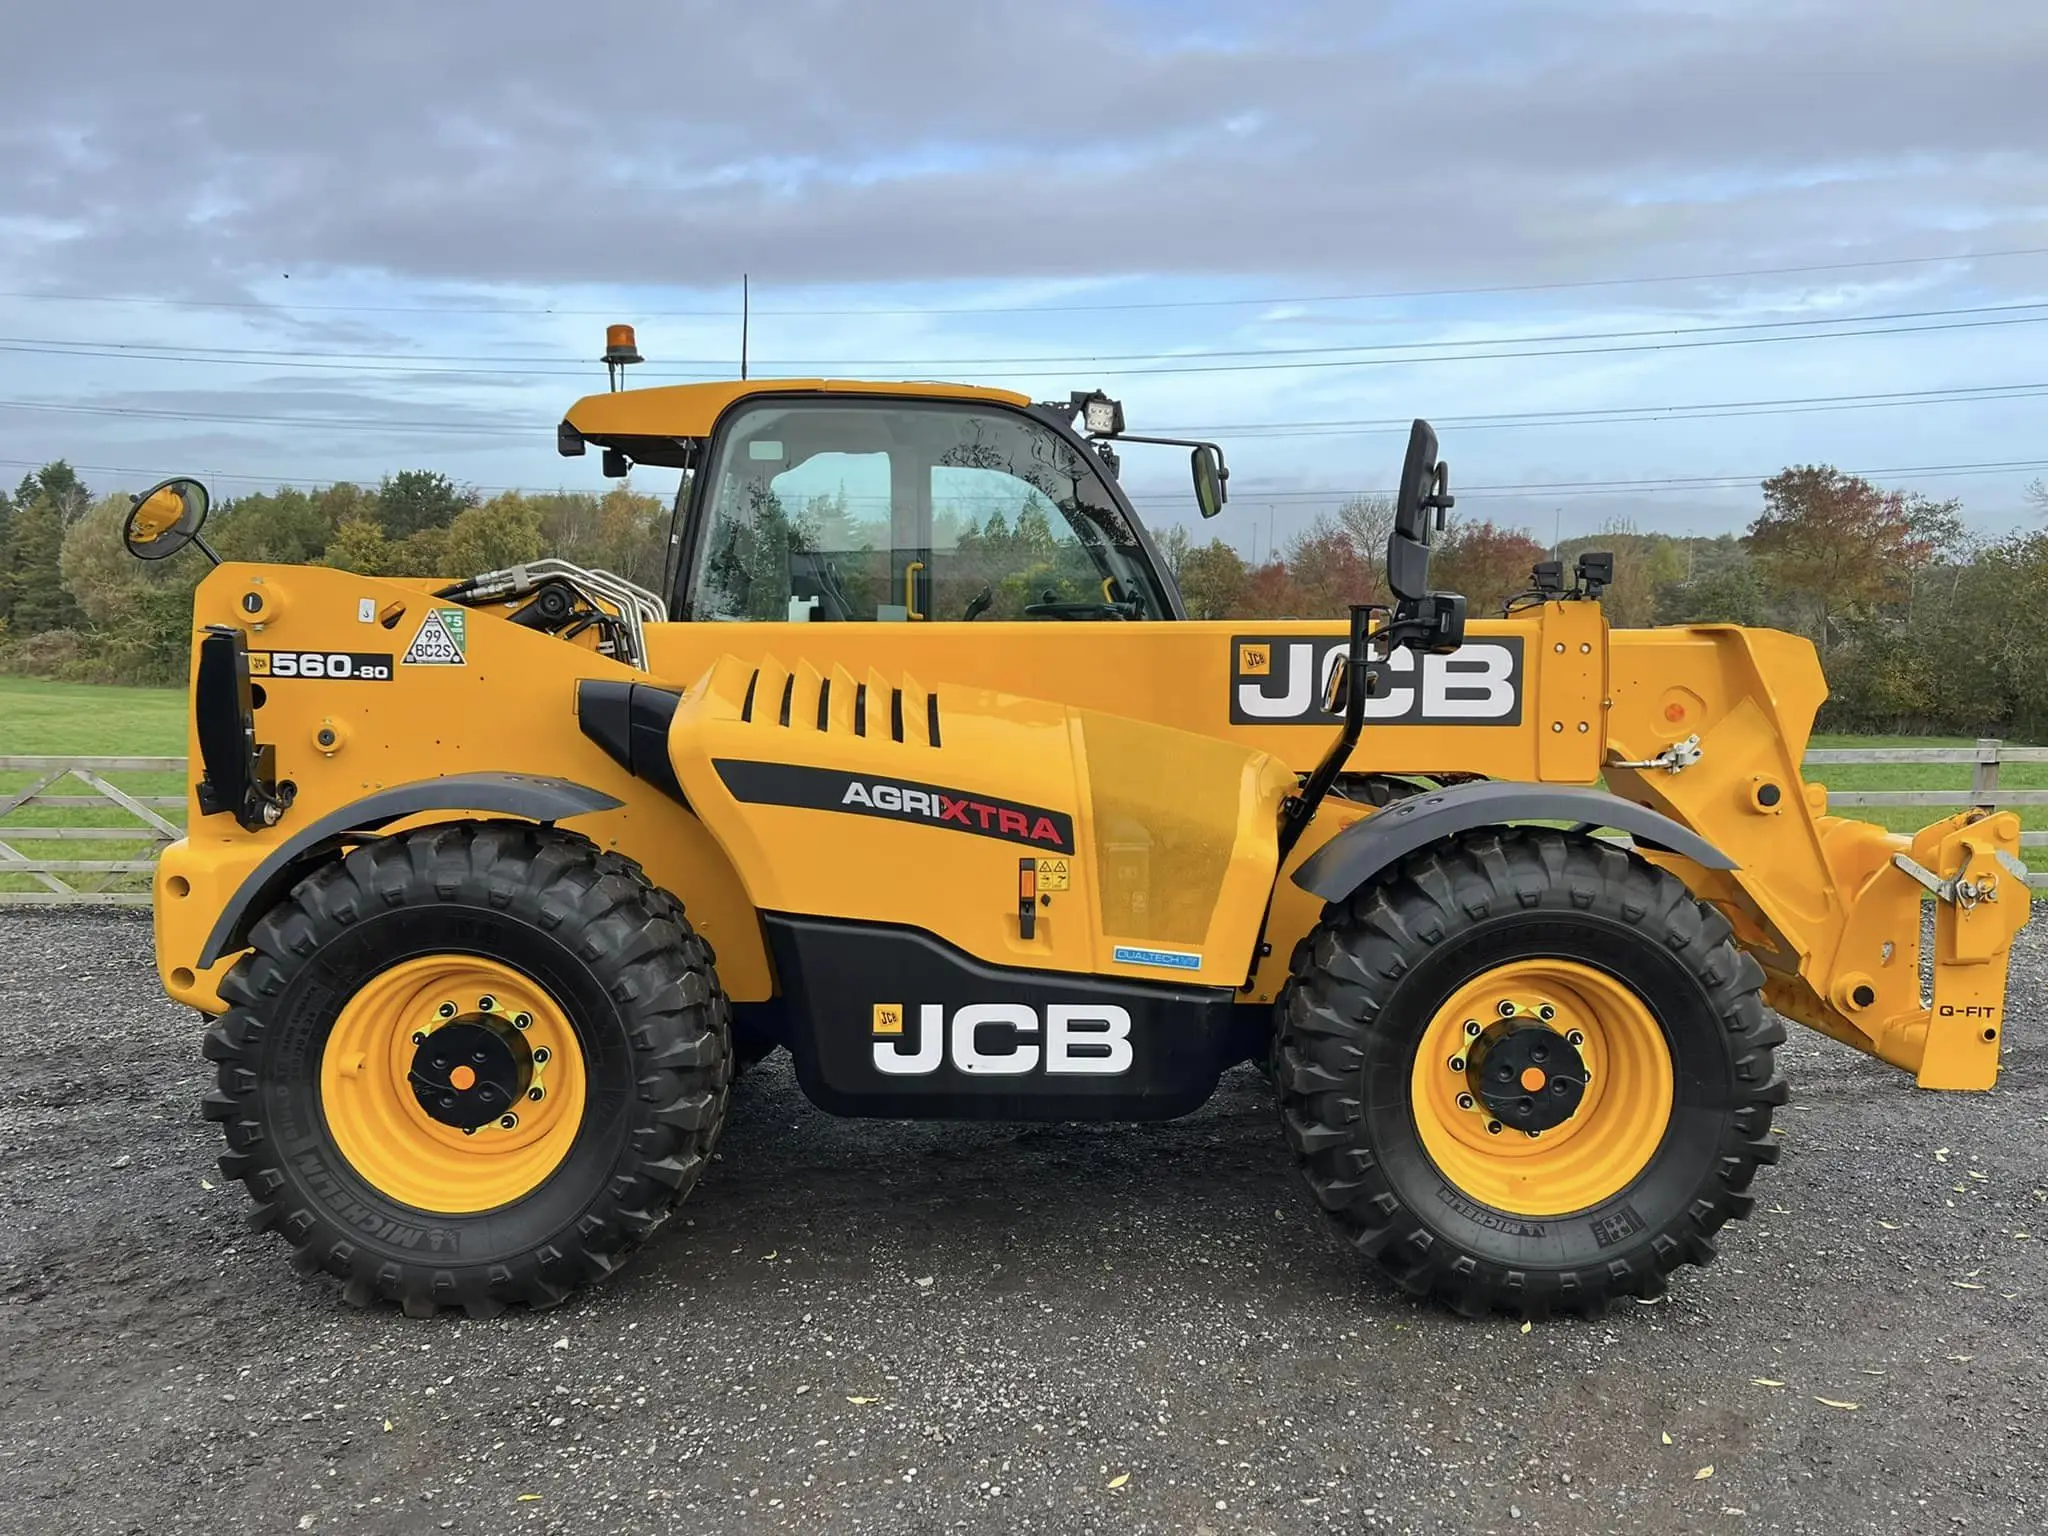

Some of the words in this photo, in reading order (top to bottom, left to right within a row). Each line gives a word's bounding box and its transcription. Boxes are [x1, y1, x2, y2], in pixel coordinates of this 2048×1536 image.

[415, 643, 452, 658] BC2S
[424, 629, 442, 643] 99
[1238, 643, 1515, 718] JCB
[842, 781, 1063, 844] AGRIXTRA
[872, 1003, 1134, 1074] JCB
[1938, 1005, 1996, 1019] Q-FIT
[292, 1148, 427, 1249] MICHELIN
